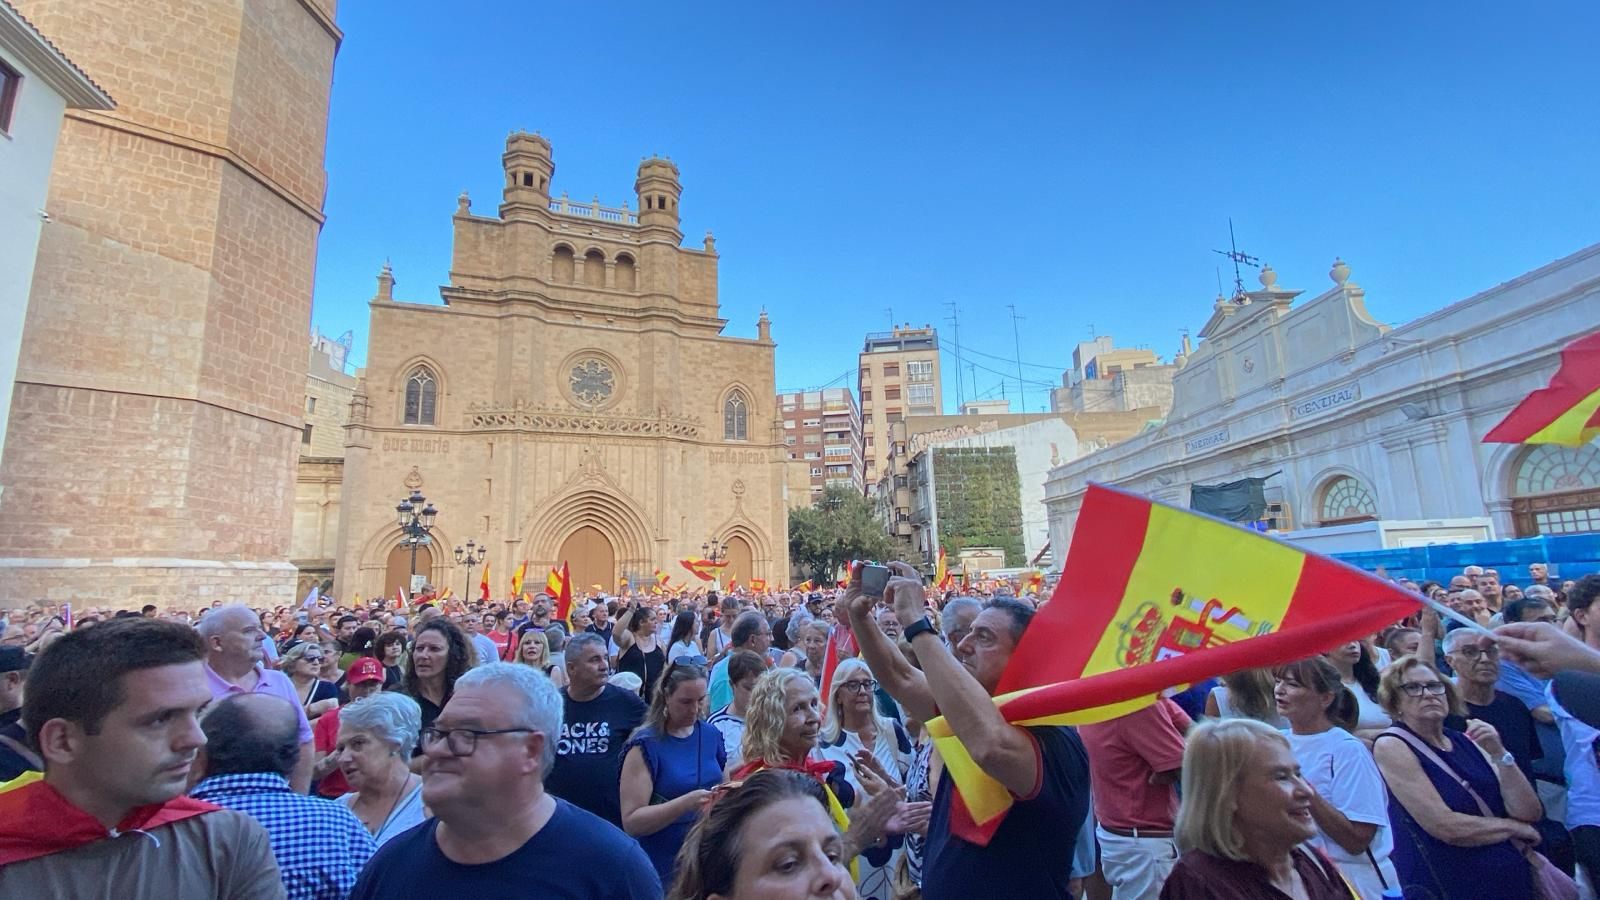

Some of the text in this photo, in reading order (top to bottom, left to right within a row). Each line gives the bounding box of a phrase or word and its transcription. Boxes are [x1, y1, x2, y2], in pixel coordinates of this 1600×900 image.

[1297, 390, 1353, 416] CENTRAL
[561, 721, 610, 738] ACK&
[557, 738, 609, 755] ONES
